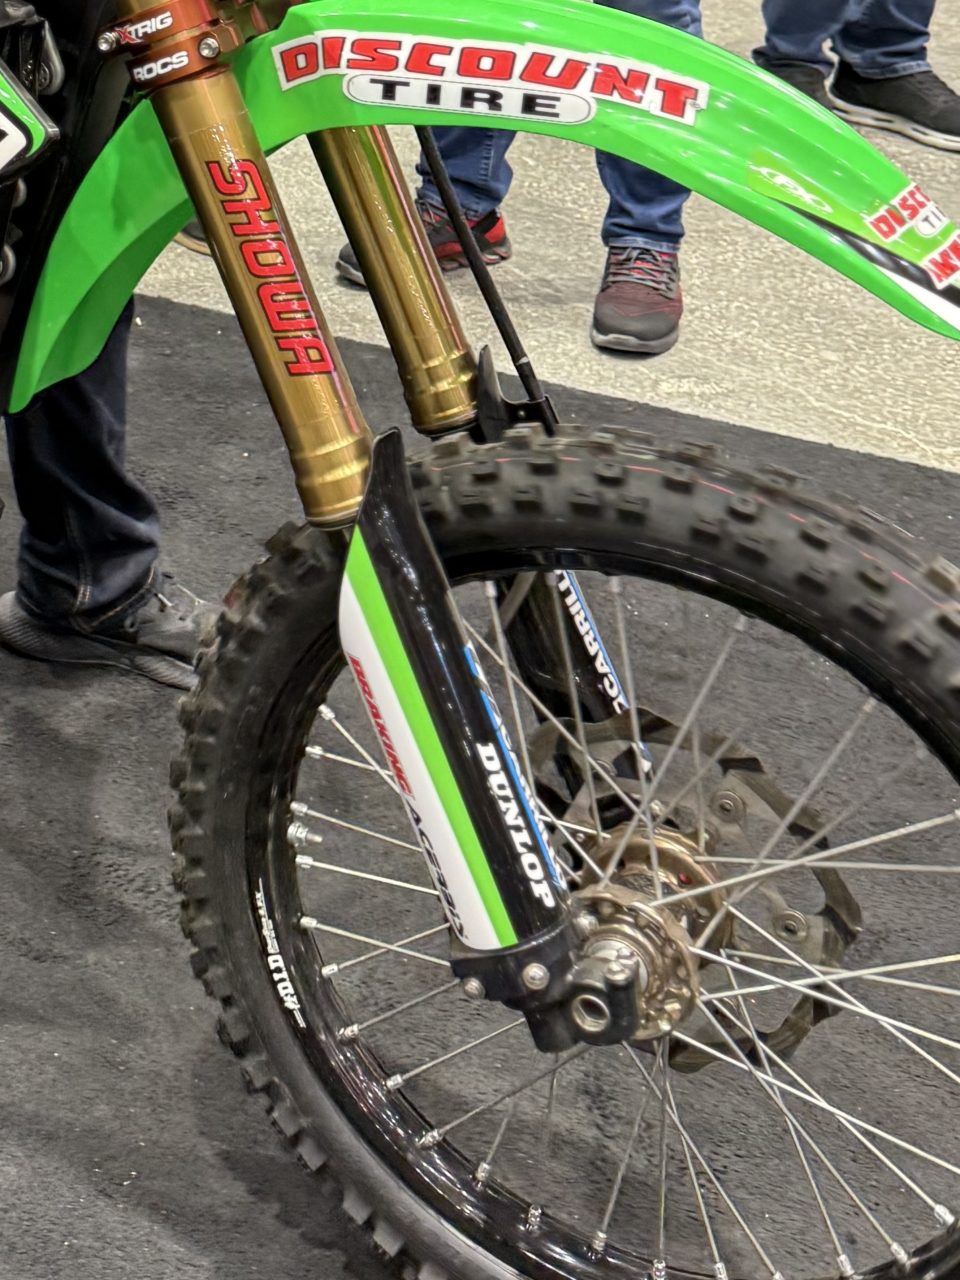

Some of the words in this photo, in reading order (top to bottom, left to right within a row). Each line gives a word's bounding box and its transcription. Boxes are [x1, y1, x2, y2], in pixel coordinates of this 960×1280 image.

[115, 11, 174, 45] XTRIG
[133, 50, 189, 81] ROCS
[280, 35, 699, 119] DISCOUNT
[370, 77, 561, 119] TIRE
[205, 159, 336, 377] SHOWA
[476, 741, 556, 909] DUNLOP
